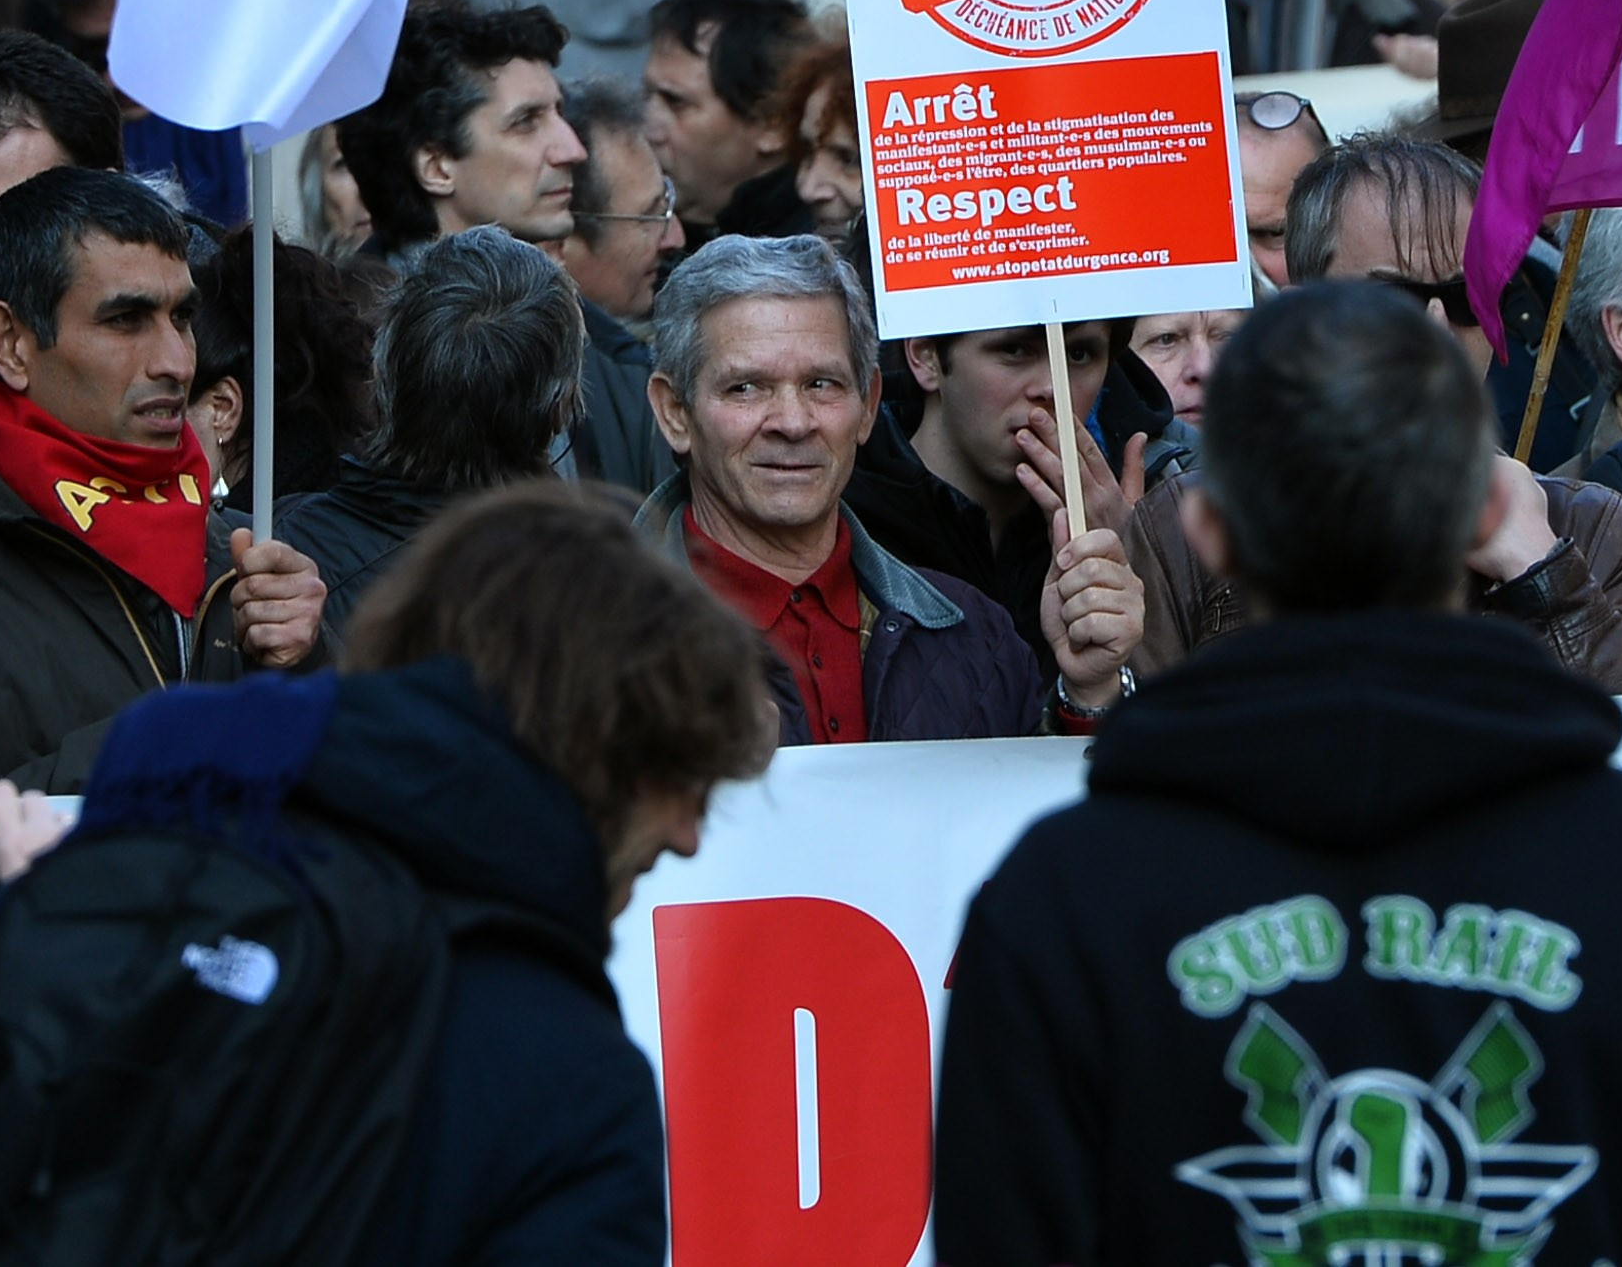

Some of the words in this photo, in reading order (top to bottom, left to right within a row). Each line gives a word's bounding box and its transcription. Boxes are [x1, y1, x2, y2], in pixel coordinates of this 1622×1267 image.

[1052, 11, 1075, 38] DE
[881, 83, 998, 129] Arrêt
[874, 134, 892, 147] de
[895, 133, 908, 145] la
[911, 125, 988, 144] répression
[989, 124, 1005, 136] et
[1007, 121, 1025, 134] de
[1027, 119, 1041, 132] la
[1044, 111, 1148, 132] stigmatisation
[1149, 109, 1175, 122] des
[990, 137, 1005, 149] et
[1094, 127, 1120, 140] des
[1122, 121, 1213, 139] mouvements
[877, 159, 936, 175] sociaux,
[937, 156, 963, 169] des
[1055, 145, 1081, 159] des
[1188, 136, 1207, 148] ou
[966, 166, 1008, 180] l'être,
[1010, 163, 1036, 176] des
[1037, 157, 1105, 176] quartiers
[1107, 151, 1188, 170] populaires.
[896, 174, 1078, 227] Respect
[885, 250, 905, 264] de
[906, 250, 923, 262] se
[924, 244, 970, 260] réunir
[971, 242, 987, 256] et
[988, 240, 1007, 254] de
[1008, 234, 1091, 253] s'exprimer.
[887, 236, 906, 250] de
[907, 234, 923, 248] la
[924, 228, 971, 246] liberté
[972, 228, 992, 242] de
[994, 221, 1076, 240] manifester,
[951, 248, 1171, 280] www.stopetatdurgence.org
[1167, 894, 1349, 1019] SUD
[1360, 894, 1583, 1013] RAIL
